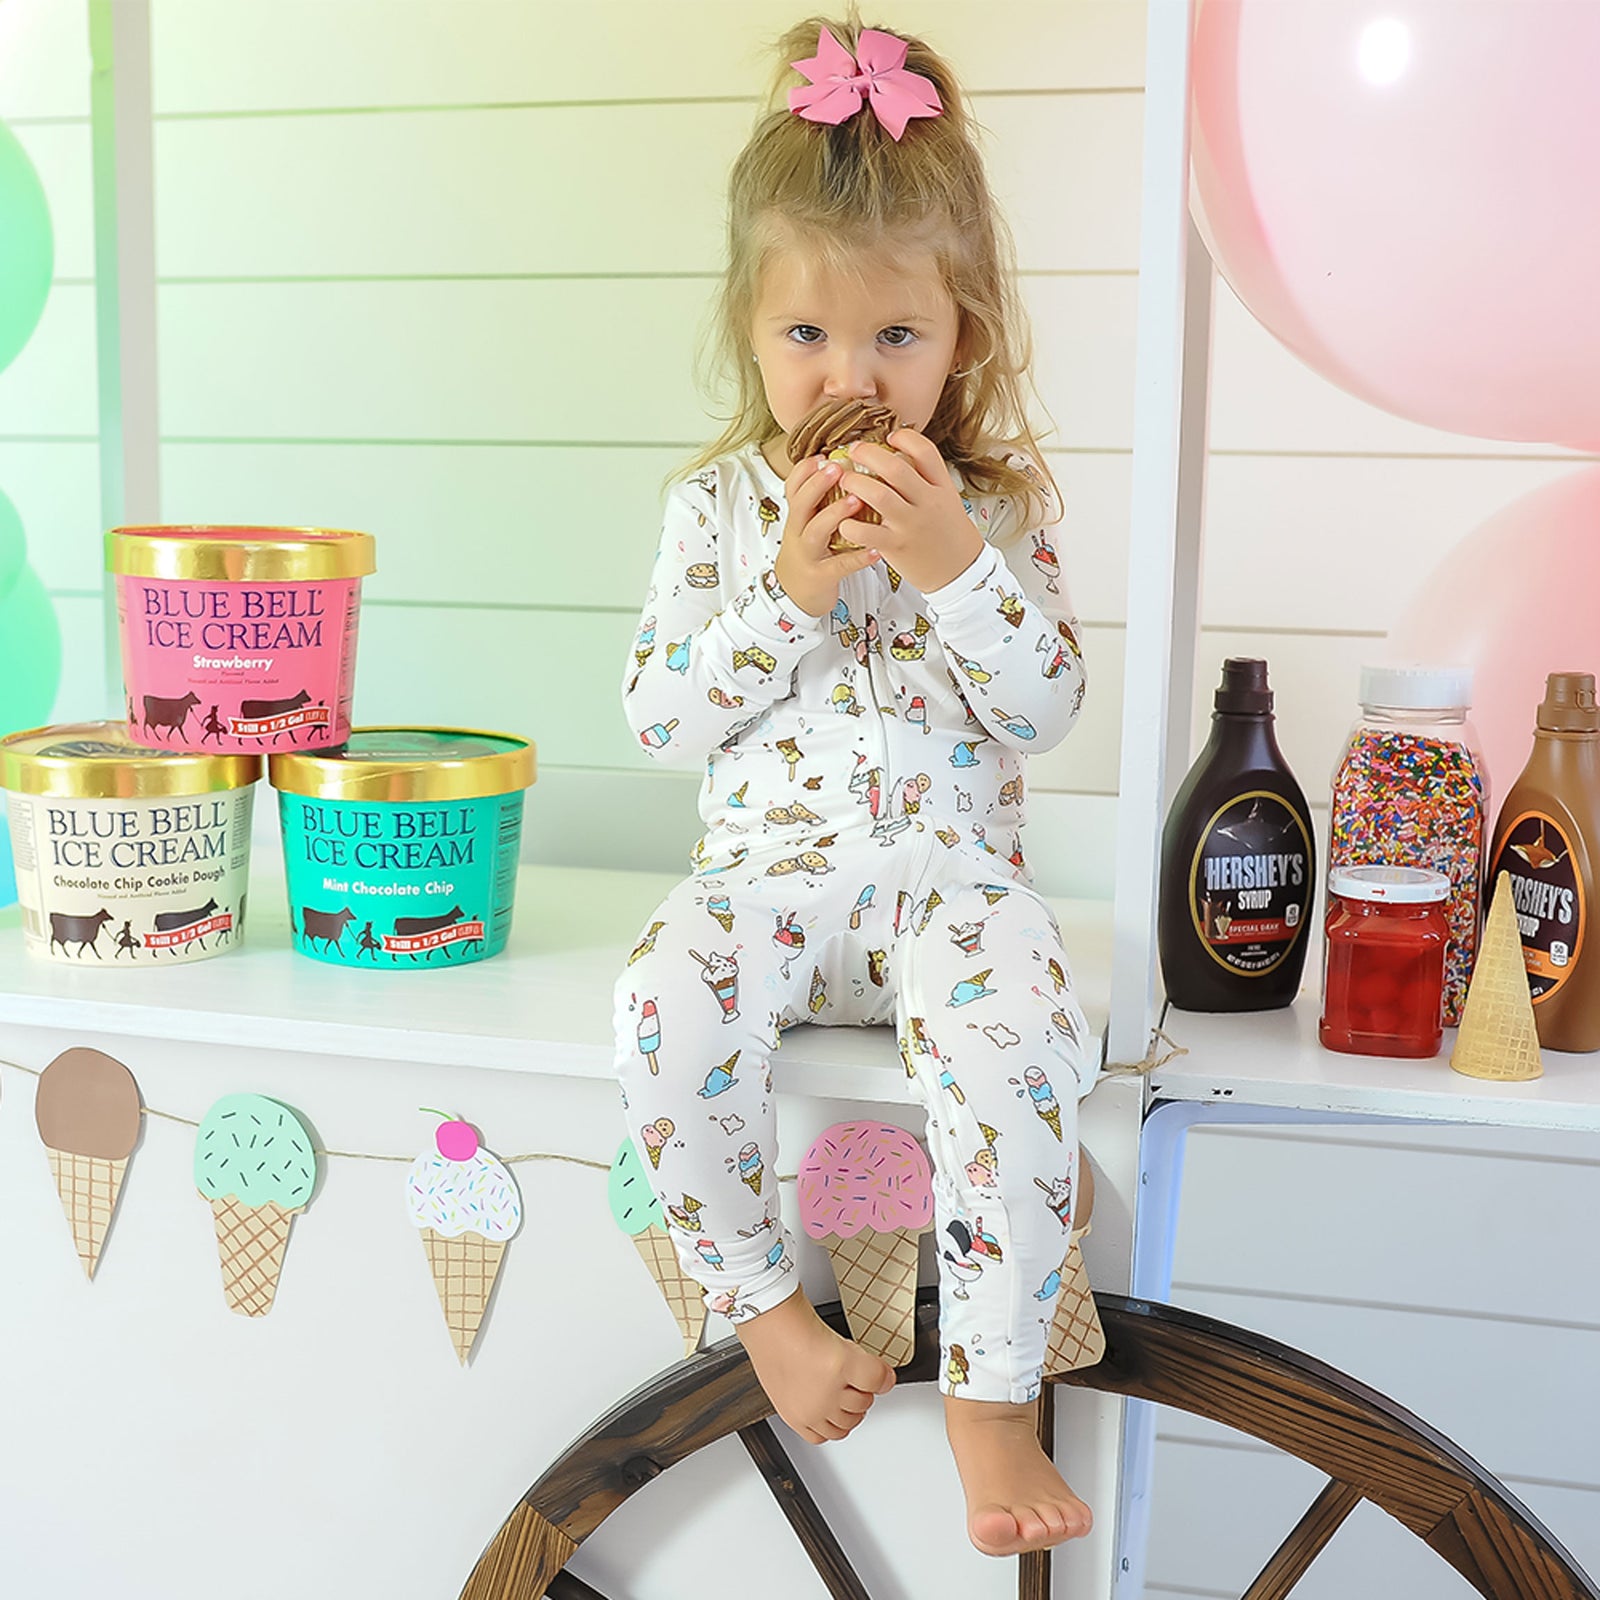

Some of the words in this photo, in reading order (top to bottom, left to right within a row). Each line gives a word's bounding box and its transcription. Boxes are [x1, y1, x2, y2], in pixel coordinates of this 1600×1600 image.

[143, 588, 231, 618] BLUE
[241, 589, 325, 618] BELL
[146, 620, 194, 649] ICE
[202, 620, 323, 650] CREAM
[193, 654, 274, 671] Strawberry
[237, 723, 259, 733] Still
[260, 724, 268, 732] a
[270, 718, 287, 730] 1/2
[287, 713, 305, 726] Gal
[46, 808, 140, 838] BLUE
[148, 801, 228, 836] BELL
[302, 804, 383, 838] BLUE
[392, 807, 477, 839] BELL
[51, 839, 103, 868] ICE
[111, 831, 227, 868] CREAM
[304, 835, 348, 866] ICE
[355, 837, 475, 869] CREAM
[53, 875, 110, 889] Chocolate
[114, 876, 143, 891] Chip
[146, 872, 189, 888] Cookie
[192, 866, 226, 883] Dough
[323, 877, 348, 892] Mint
[352, 881, 420, 896] Chocolate
[424, 880, 454, 896] Chip
[1205, 853, 1303, 890] HERSHEY'S
[1238, 889, 1272, 910] SYRUP
[1510, 873, 1573, 924] RSHEY'S
[423, 935, 439, 947] 1/2
[440, 928, 457, 941] Gal
